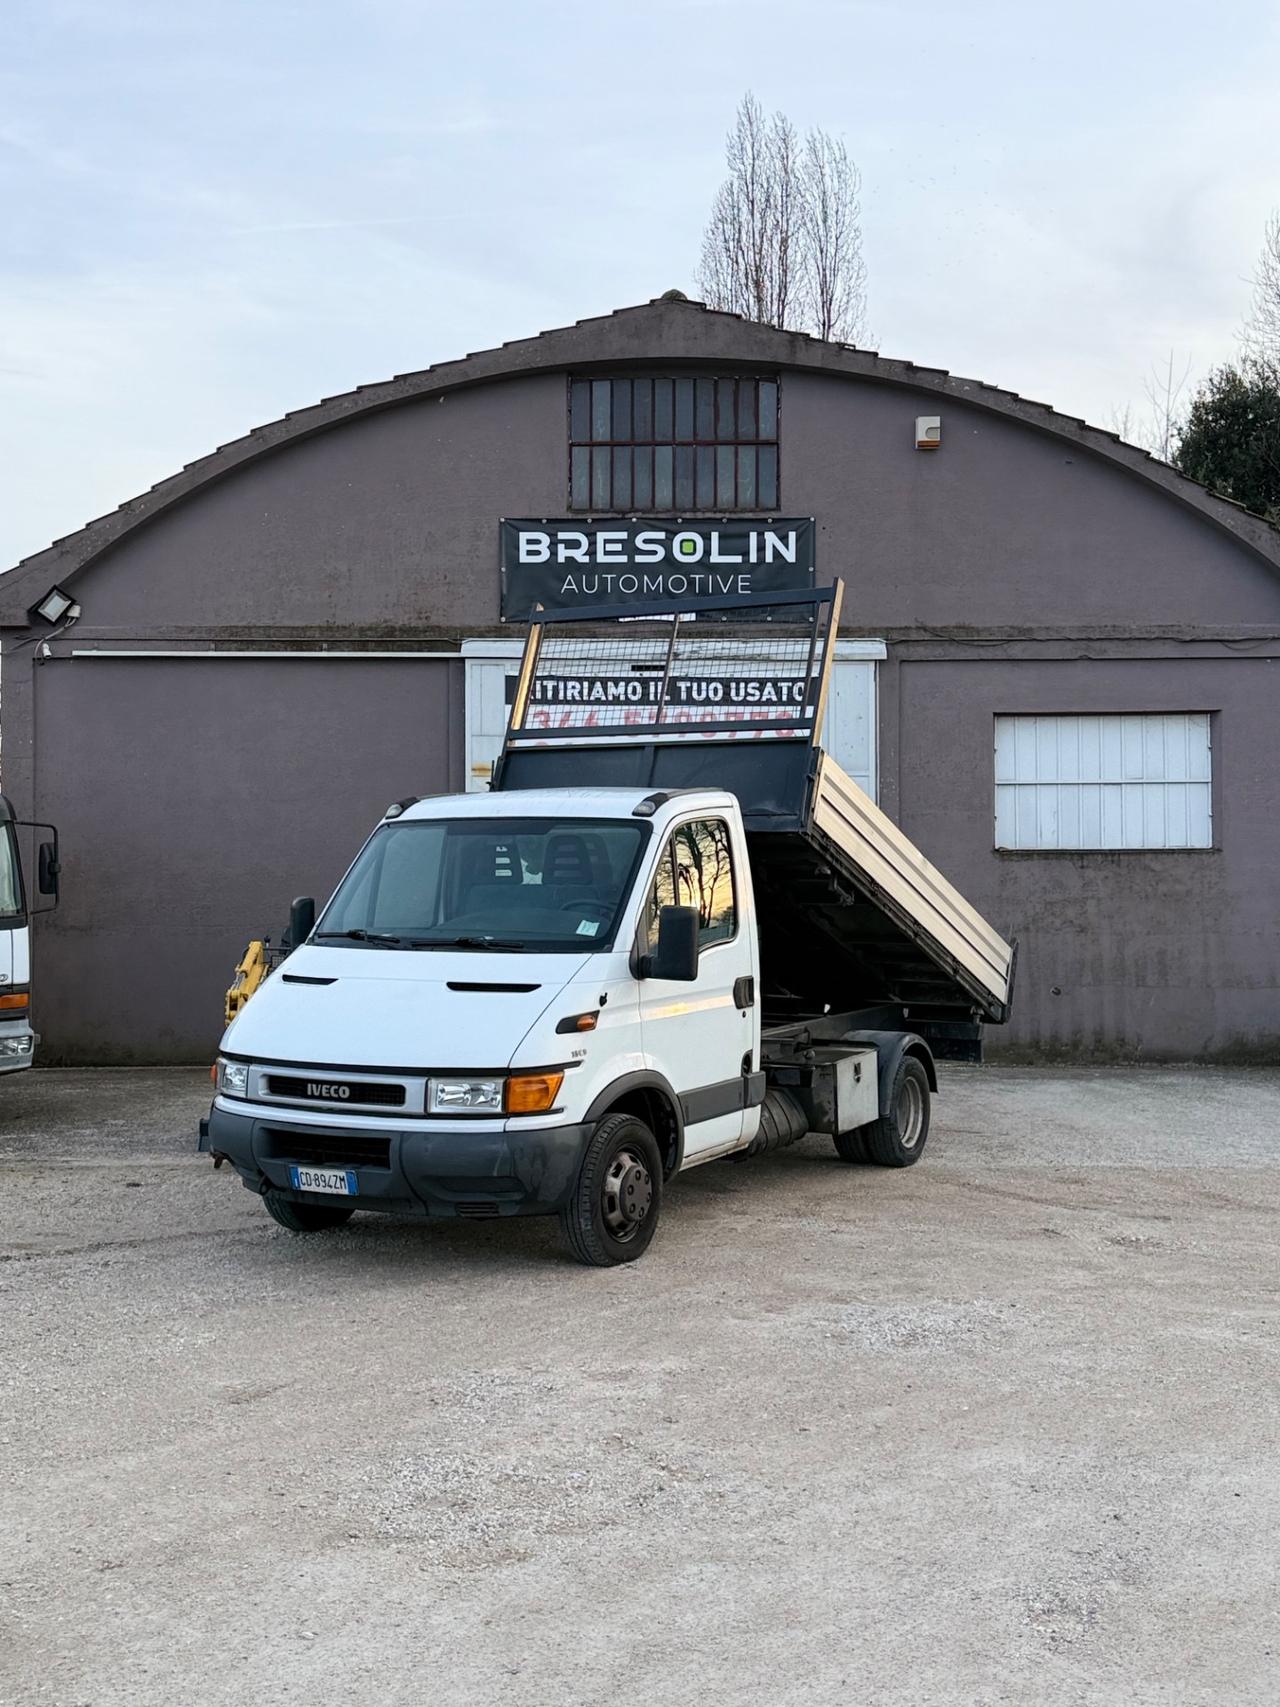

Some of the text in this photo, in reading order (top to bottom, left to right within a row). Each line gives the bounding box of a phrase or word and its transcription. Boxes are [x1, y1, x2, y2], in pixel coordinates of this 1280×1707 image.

[518, 531, 797, 563] BRESOLIN
[560, 574, 752, 594] AUTOMOTIVE
[530, 680, 643, 701] ITIRIAMO
[676, 681, 724, 701] TUO
[307, 1083, 350, 1099] IVECO
